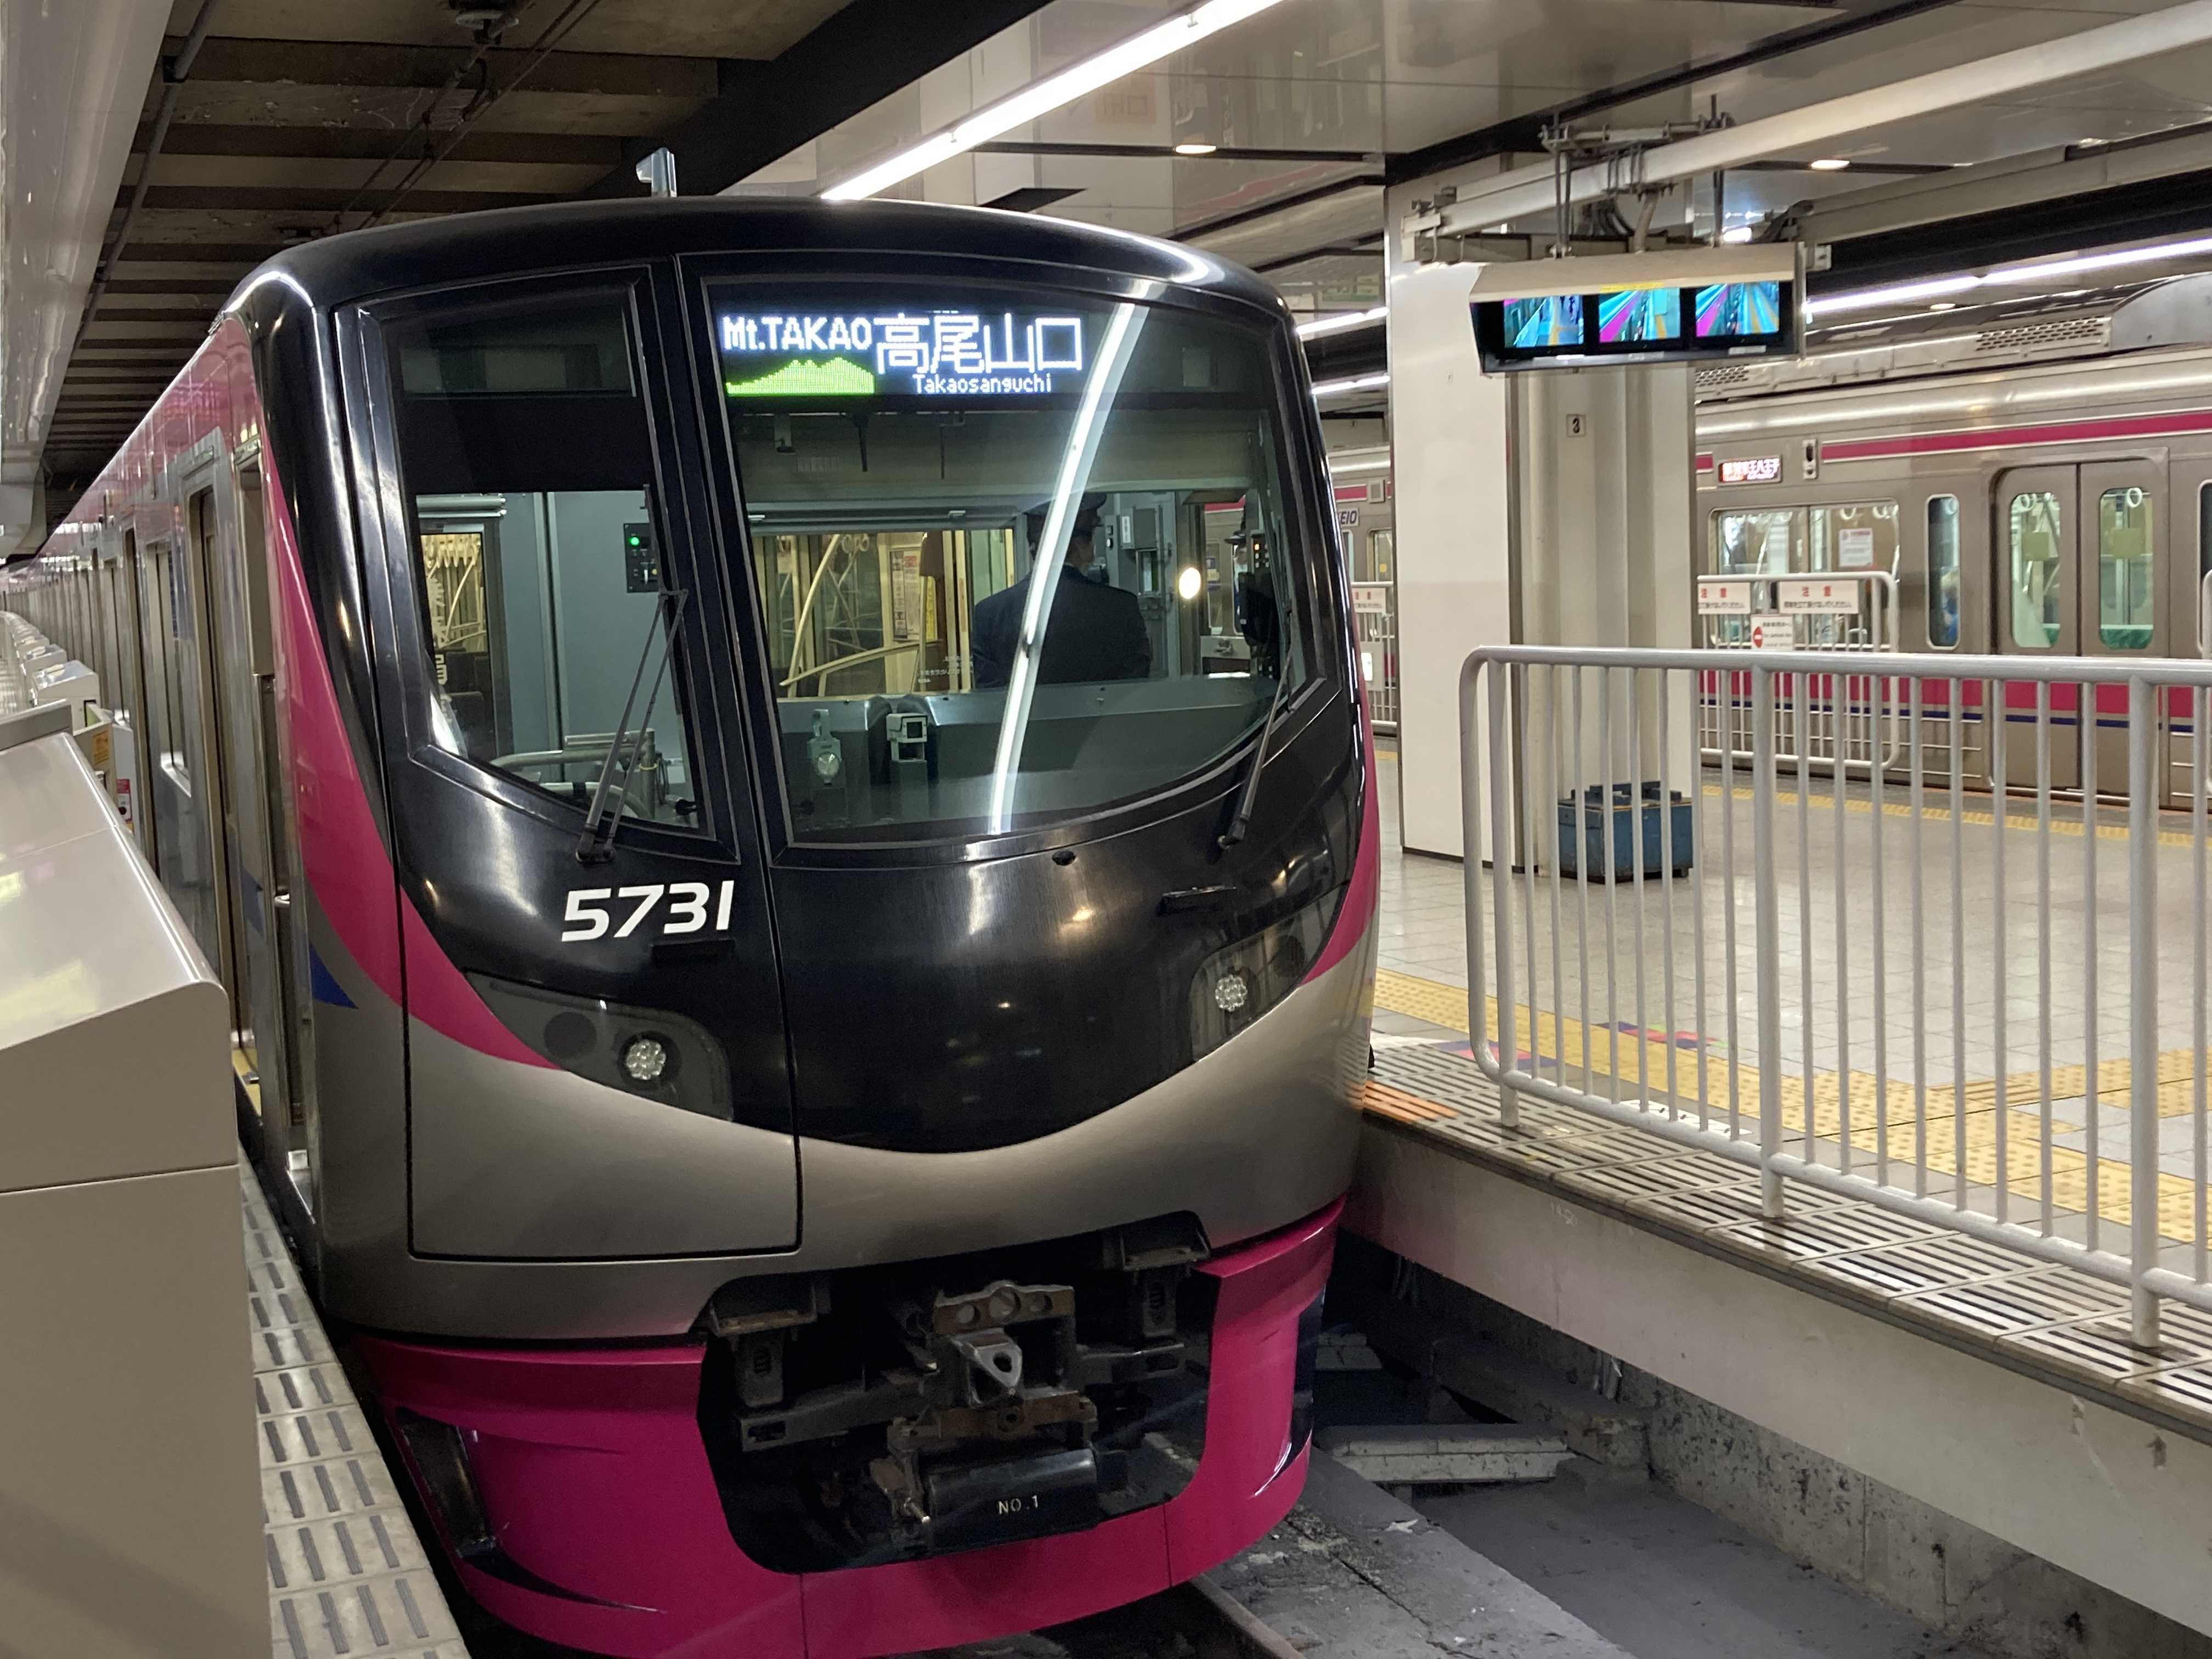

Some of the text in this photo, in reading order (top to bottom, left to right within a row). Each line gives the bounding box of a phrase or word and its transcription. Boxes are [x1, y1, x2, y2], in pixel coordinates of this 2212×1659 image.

[873, 312, 1084, 375] 高尾山口
[912, 373, 1052, 394] Takaosanguchi
[562, 880, 734, 942] 5731
